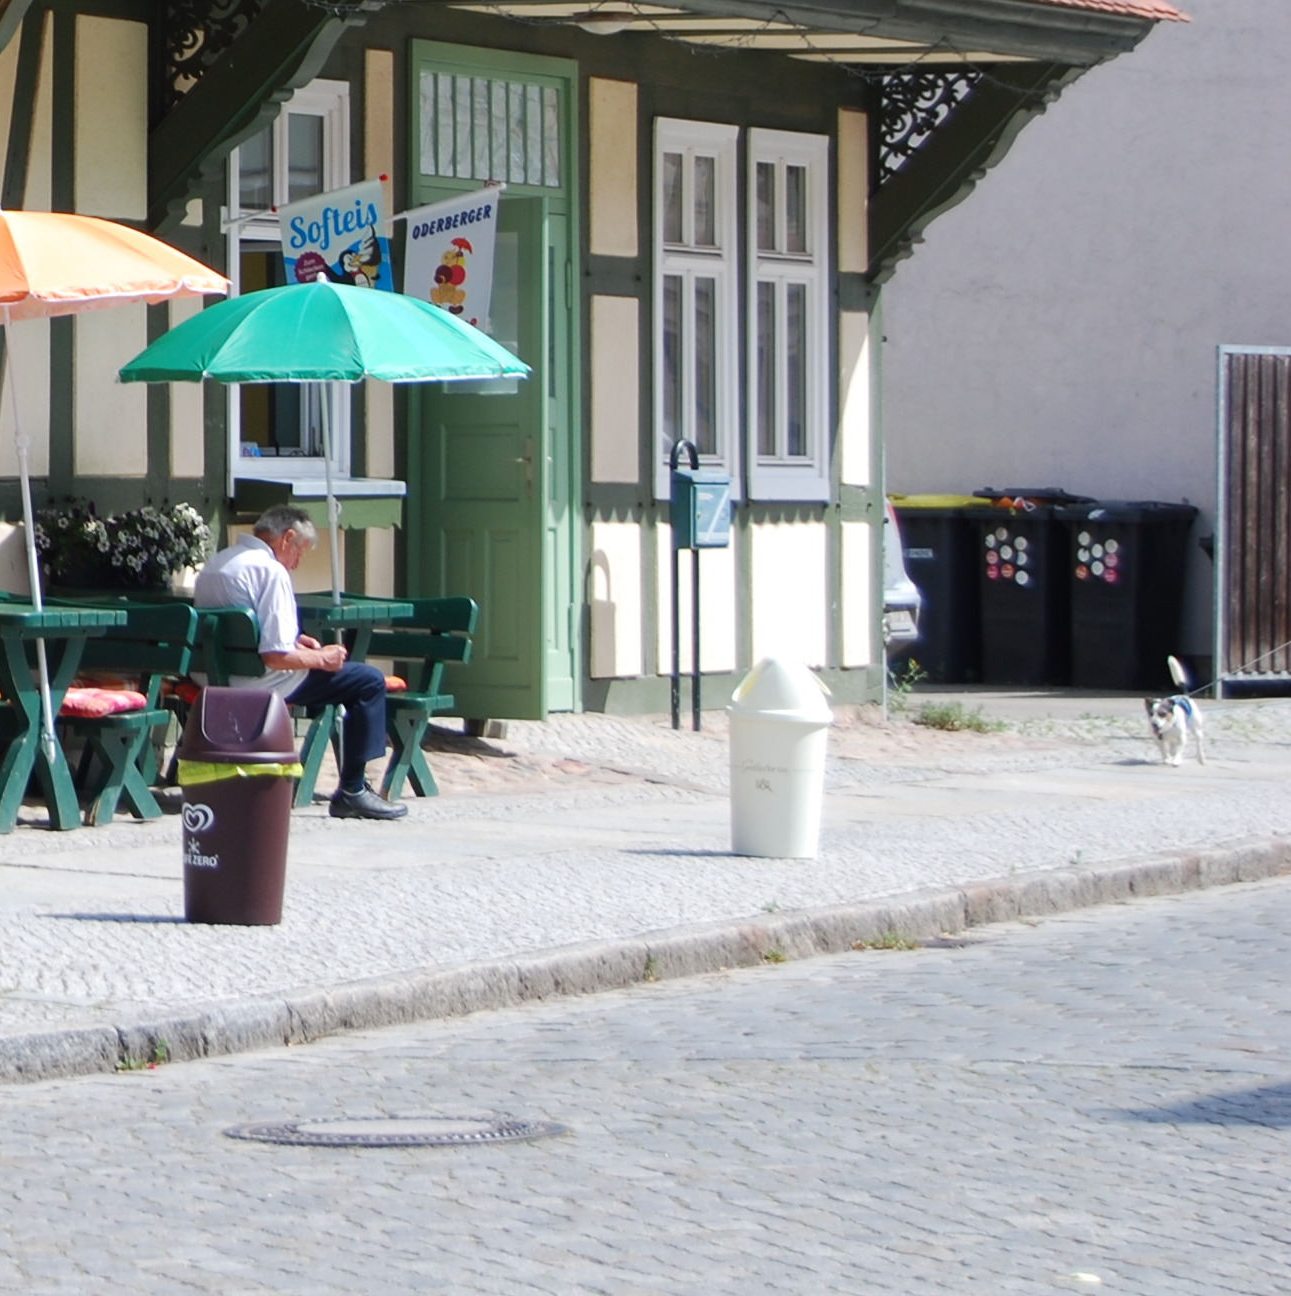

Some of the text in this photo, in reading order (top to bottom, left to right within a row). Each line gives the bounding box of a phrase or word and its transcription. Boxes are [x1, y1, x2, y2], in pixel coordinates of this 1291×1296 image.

[290, 200, 377, 250] Softeis
[412, 204, 492, 240] ODERBERGER
[193, 854, 217, 867] ZERO
